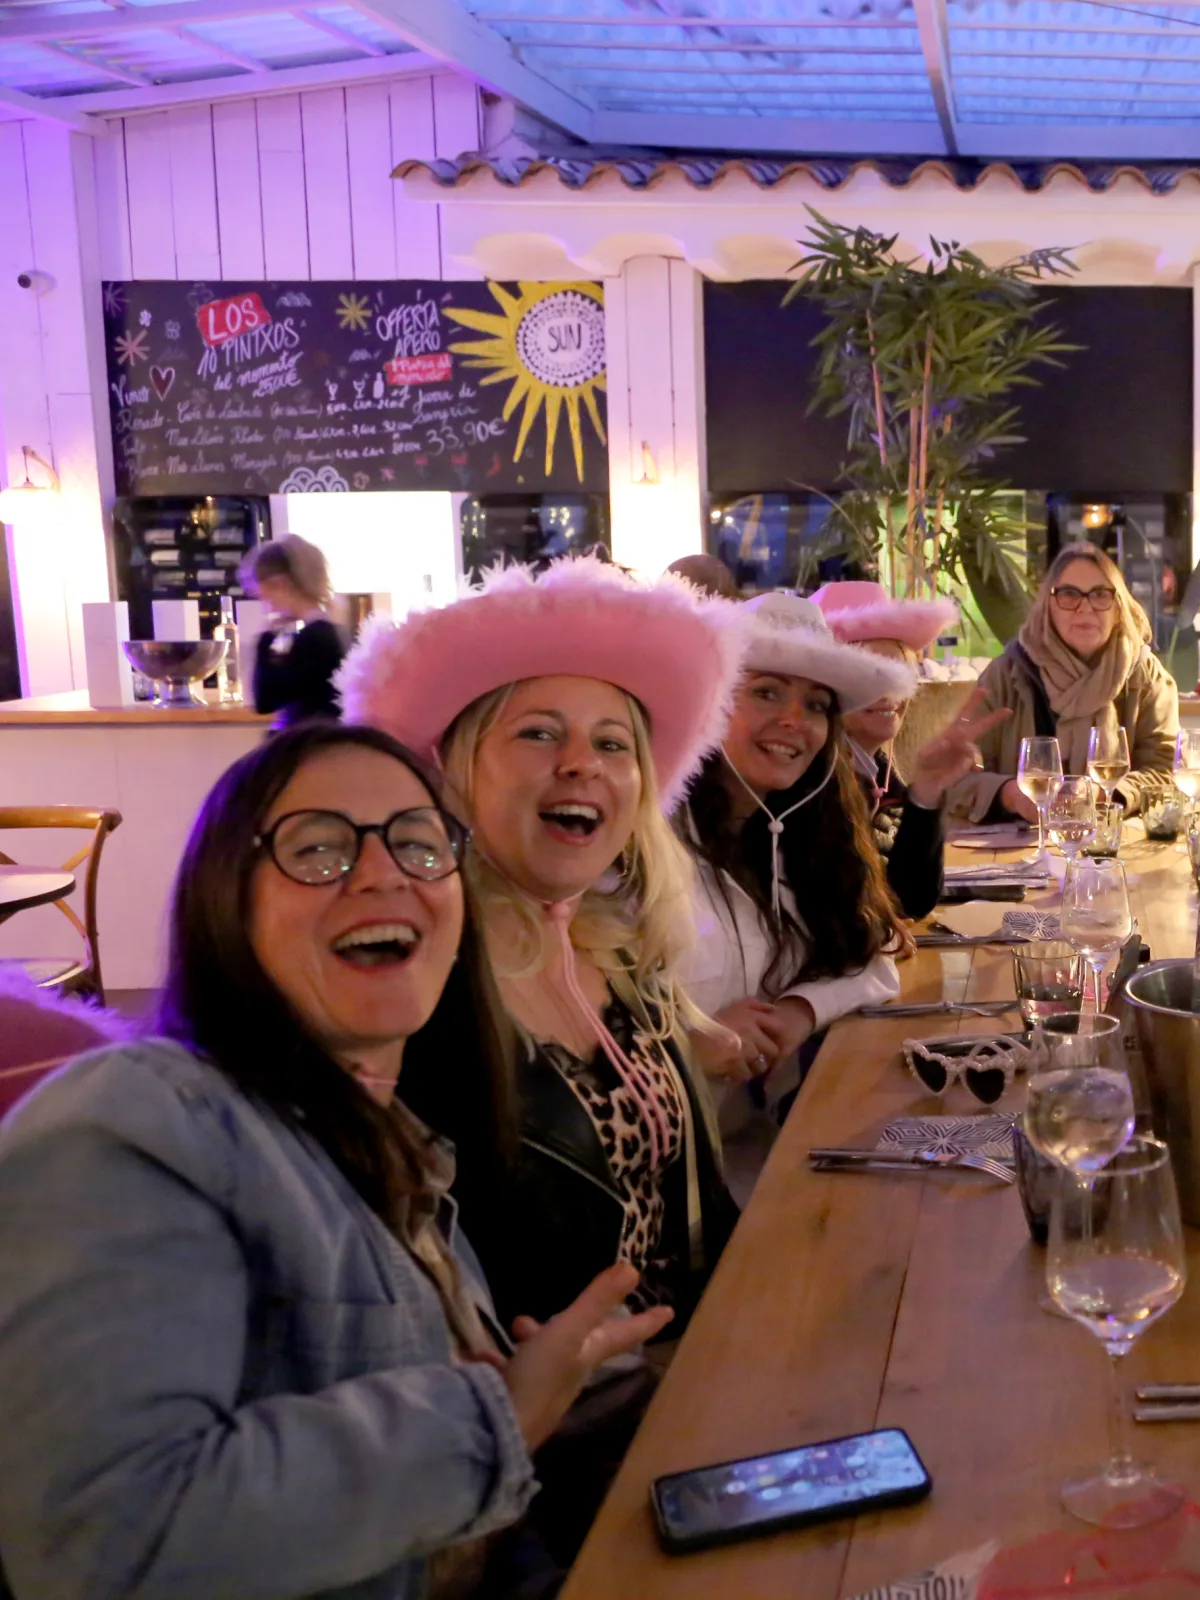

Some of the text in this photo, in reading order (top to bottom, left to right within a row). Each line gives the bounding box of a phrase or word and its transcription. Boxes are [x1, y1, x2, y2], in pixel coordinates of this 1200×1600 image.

[208, 298, 259, 341] LOS
[376, 299, 440, 341] OFFERTA
[547, 323, 582, 353] SUN
[221, 317, 300, 367] PINTXOS
[394, 330, 441, 358] APERO
[426, 417, 506, 456] 33,90€
